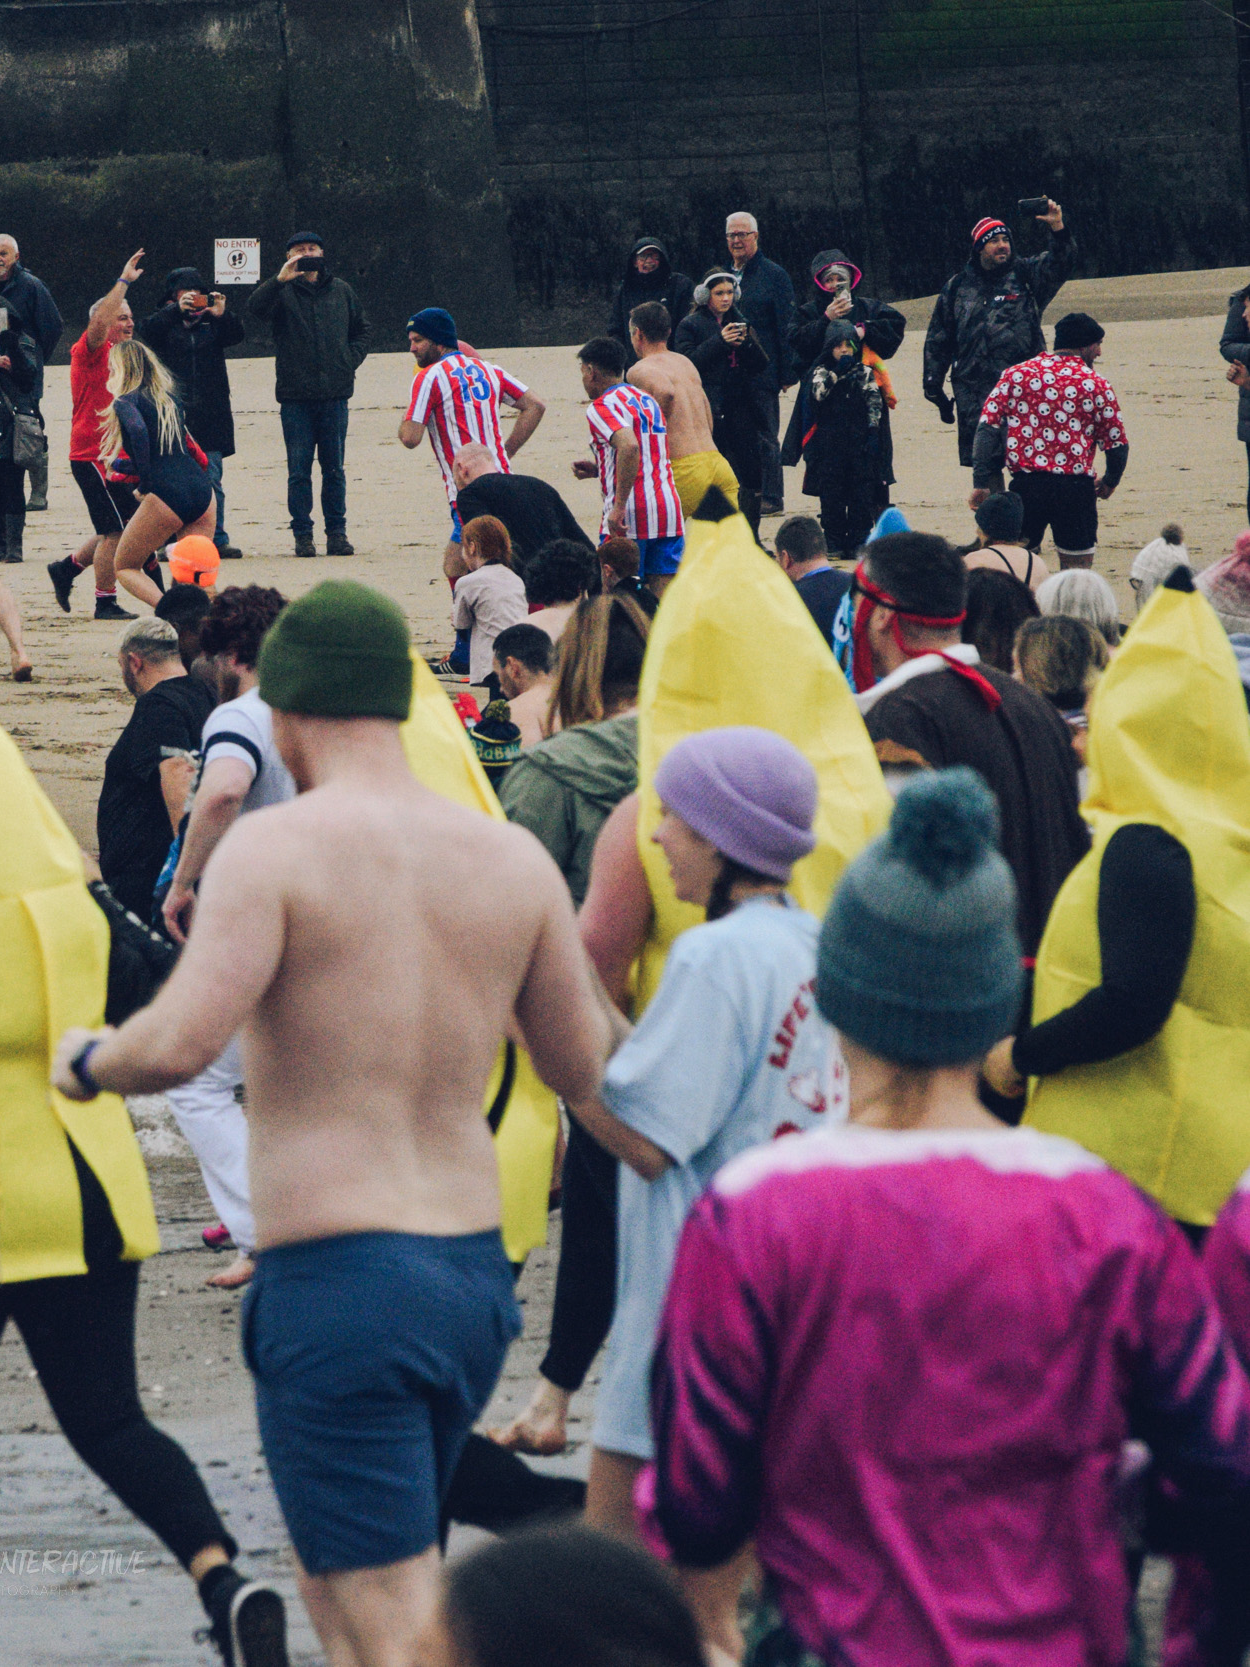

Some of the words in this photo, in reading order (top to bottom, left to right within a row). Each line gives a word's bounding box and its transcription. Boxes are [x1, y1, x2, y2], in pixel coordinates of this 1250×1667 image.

[216, 240, 229, 248] NO
[231, 240, 258, 248] ENTRY
[451, 364, 491, 403] 13
[627, 395, 667, 434] 12
